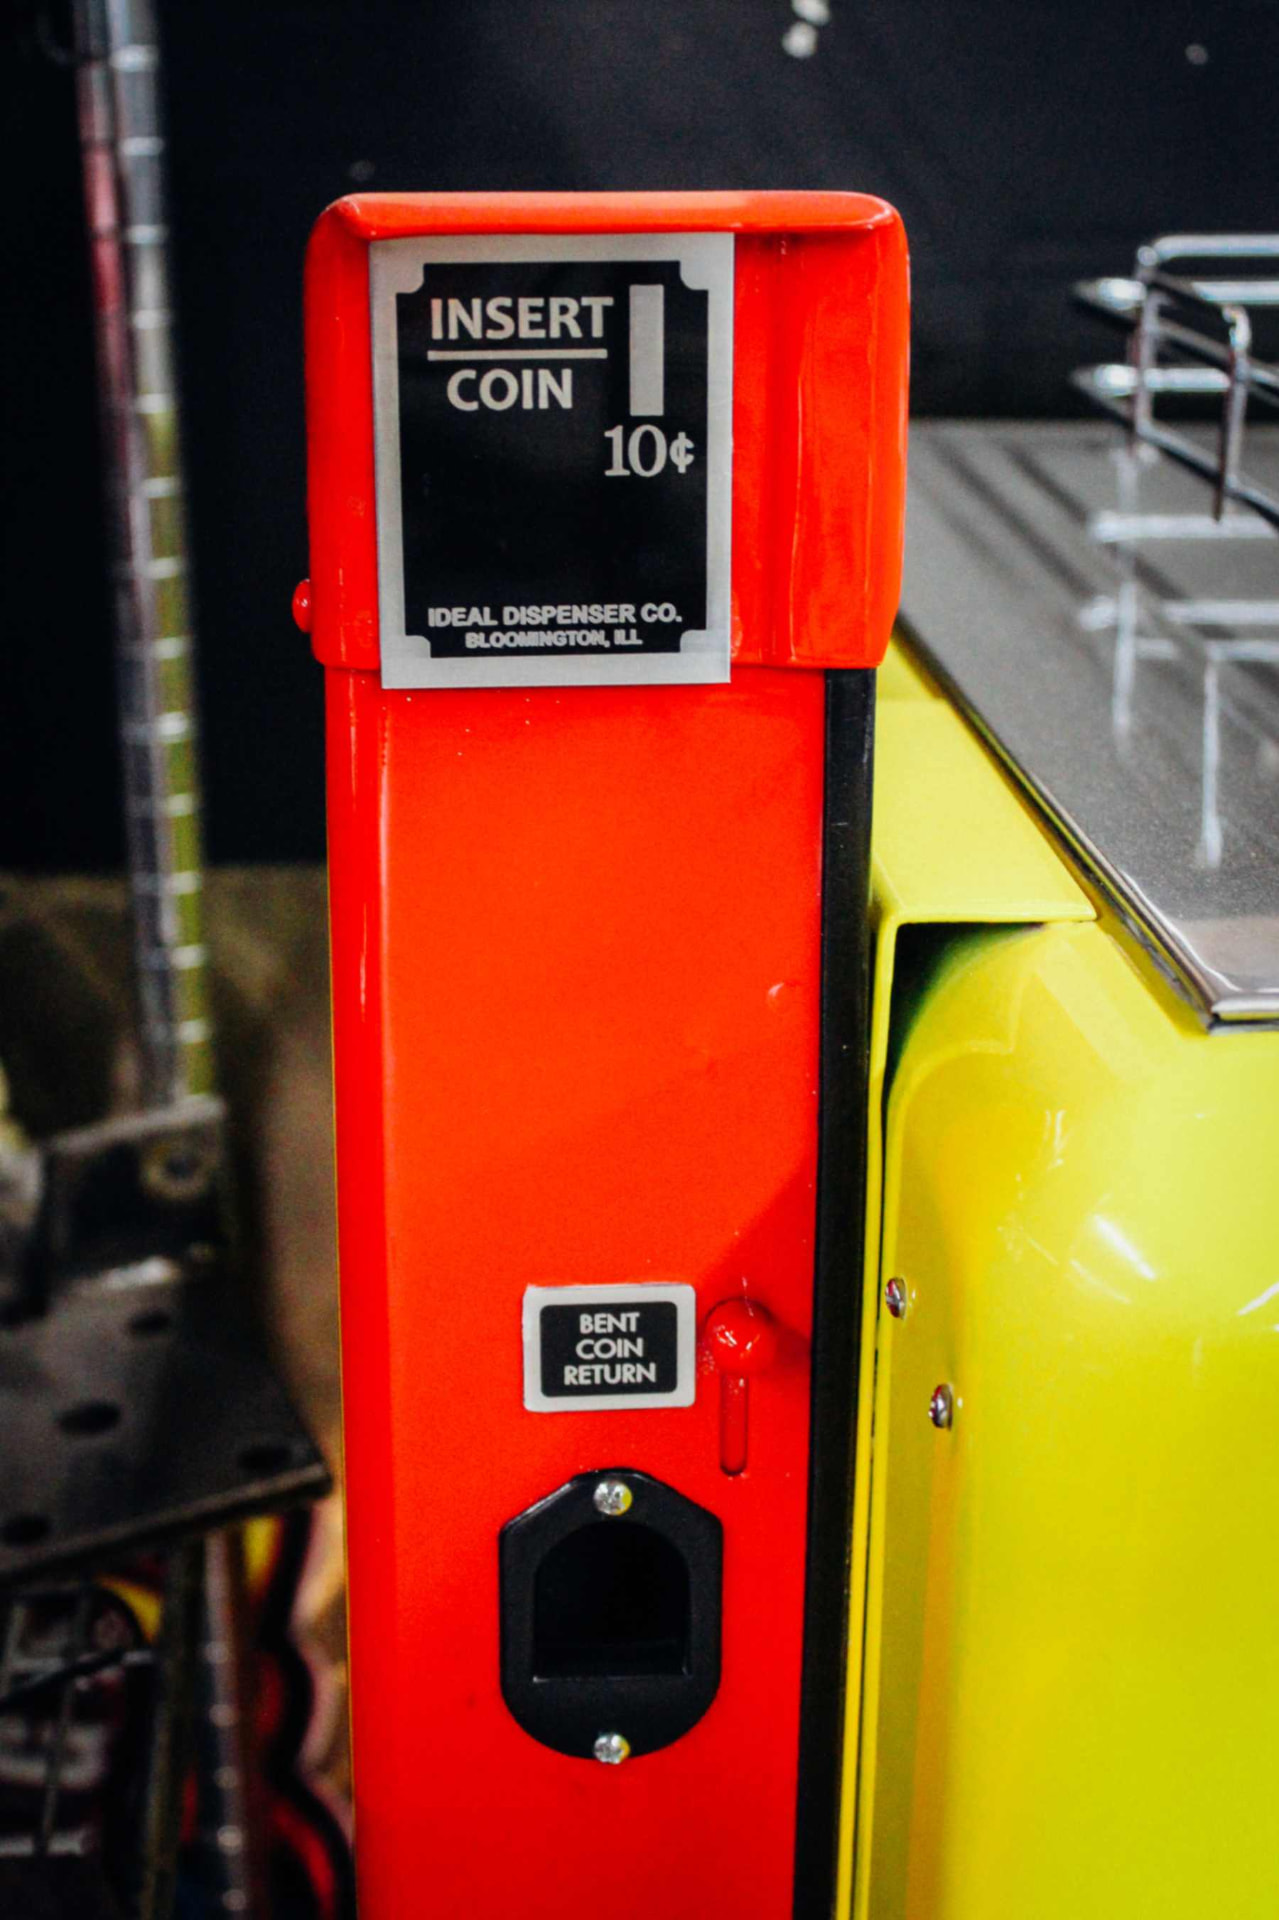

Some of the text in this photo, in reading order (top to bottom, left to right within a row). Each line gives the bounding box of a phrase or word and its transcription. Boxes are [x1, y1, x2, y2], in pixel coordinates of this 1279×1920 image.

[430, 296, 614, 340] INSERT
[446, 368, 573, 411] COIN
[604, 424, 695, 478] 10¢
[428, 603, 682, 628] IDEAL DISPENSER CO.
[465, 630, 610, 650] BLOOMINGTON,
[579, 1312, 640, 1334] BENT
[575, 1338, 643, 1360] COIN
[563, 1362, 656, 1386] RETURN
